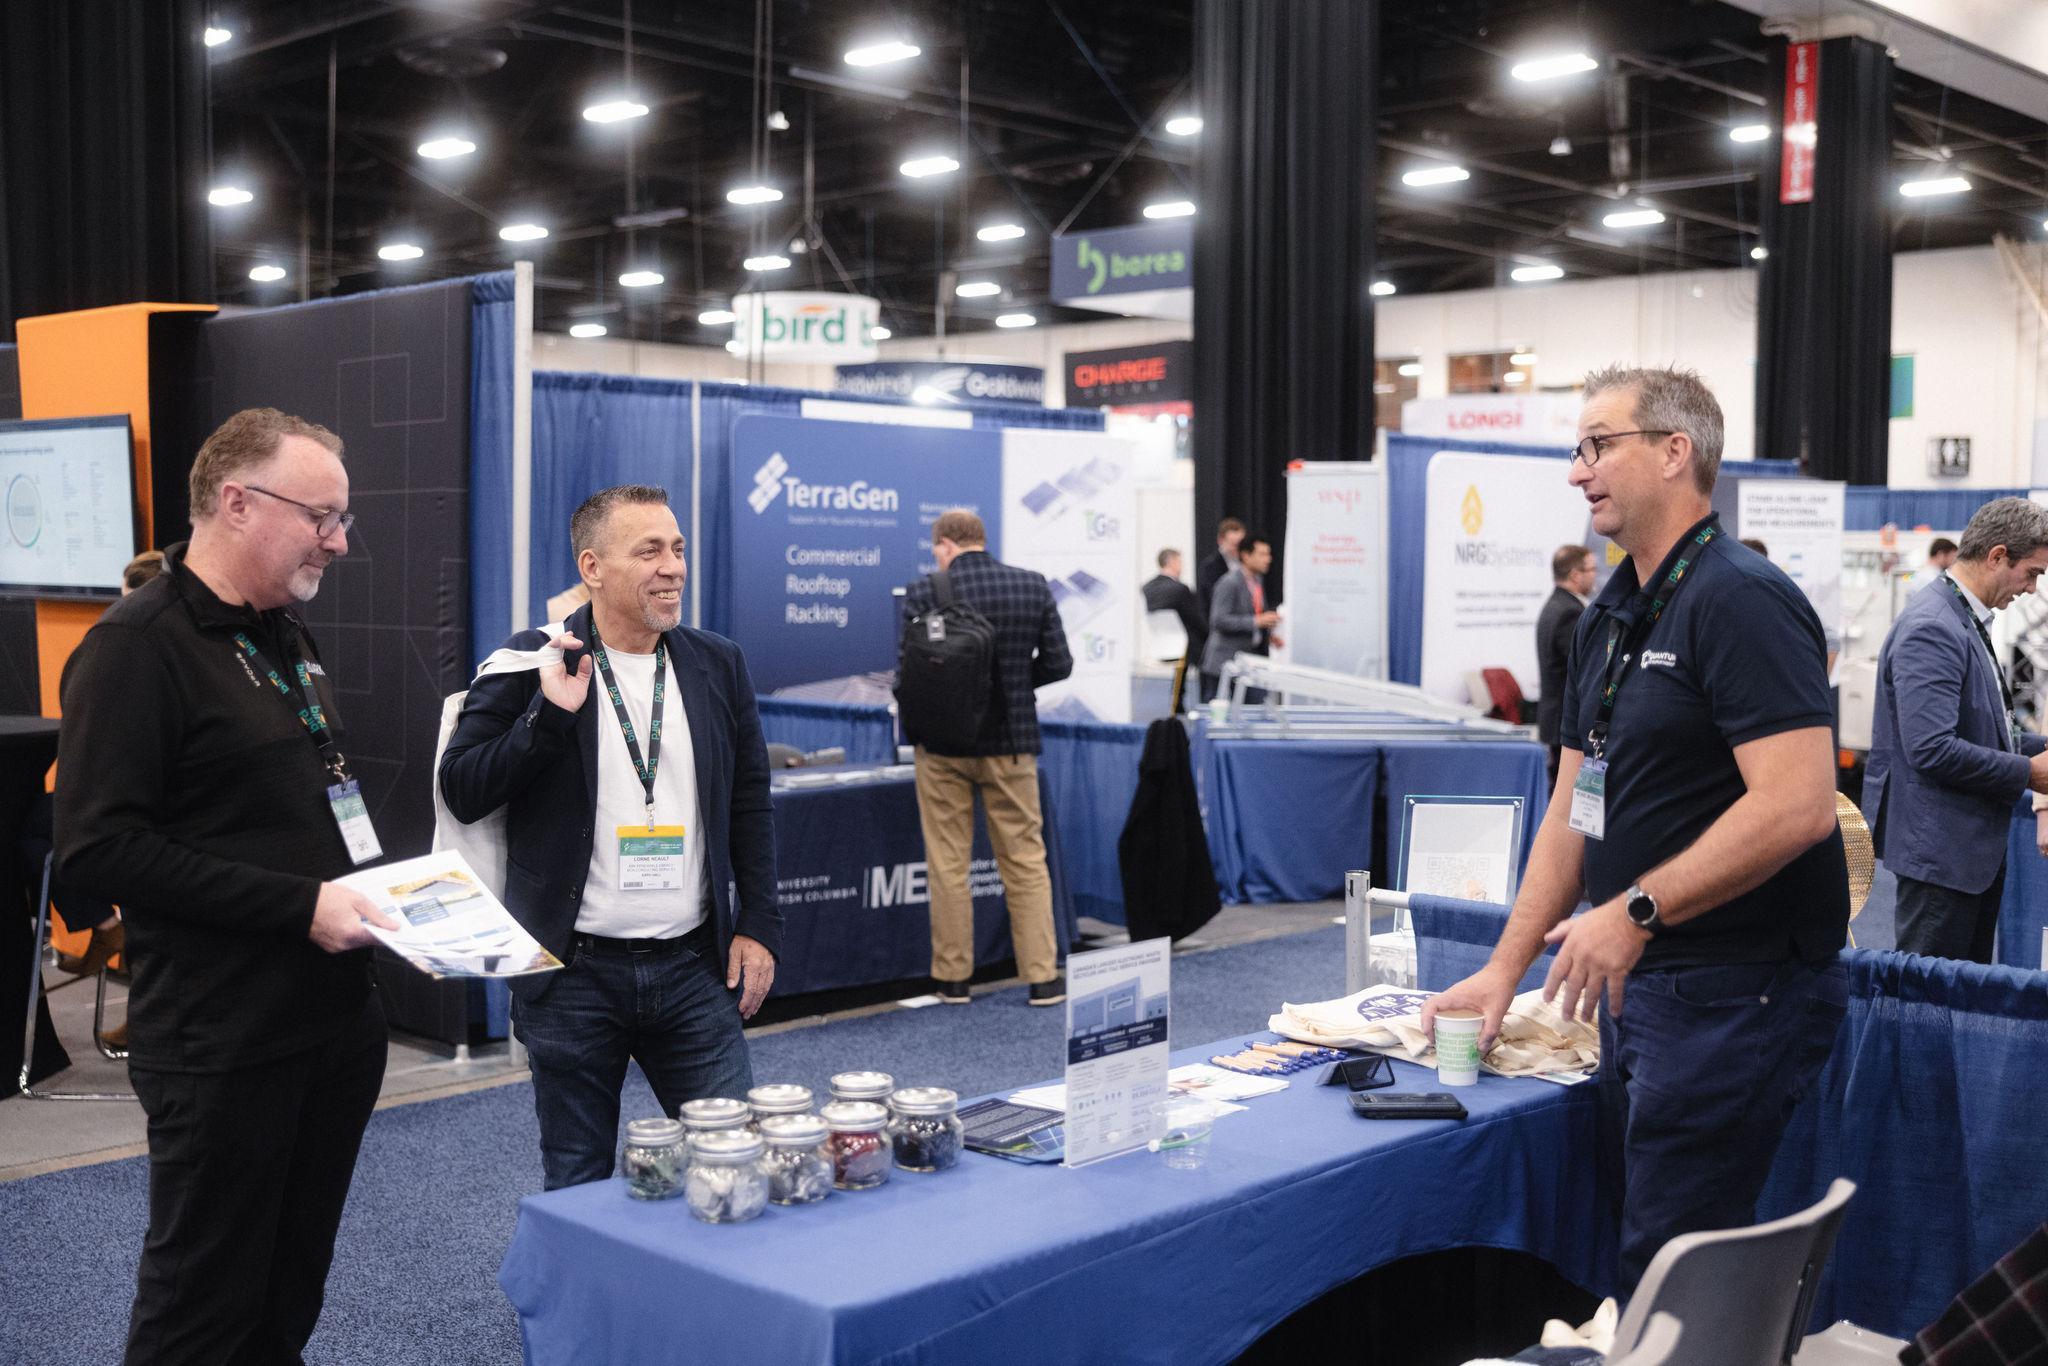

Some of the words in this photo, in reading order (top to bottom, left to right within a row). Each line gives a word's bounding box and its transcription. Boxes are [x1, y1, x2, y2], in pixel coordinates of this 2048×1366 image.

[1111, 251, 1185, 279] borea
[763, 307, 846, 343] bird
[782, 477, 899, 512] TerraGen
[1695, 526, 1717, 545] bird
[785, 545, 881, 566] Commercial
[1668, 558, 1690, 584] bird
[785, 573, 851, 598] Rooftop
[785, 603, 849, 628] Racking
[596, 650, 610, 671] bird
[267, 670, 290, 694] bird
[654, 683, 665, 703] bird
[608, 686, 623, 706] bird
[299, 708, 320, 734] bird
[622, 721, 636, 743] bird
[651, 720, 662, 741] bird
[634, 759, 647, 781] bird
[648, 758, 658, 779] bird
[777, 875, 831, 890] NIVERSITY
[870, 861, 931, 909] ME
[777, 893, 802, 905] TISH
[804, 887, 858, 903] COLUMBIA
